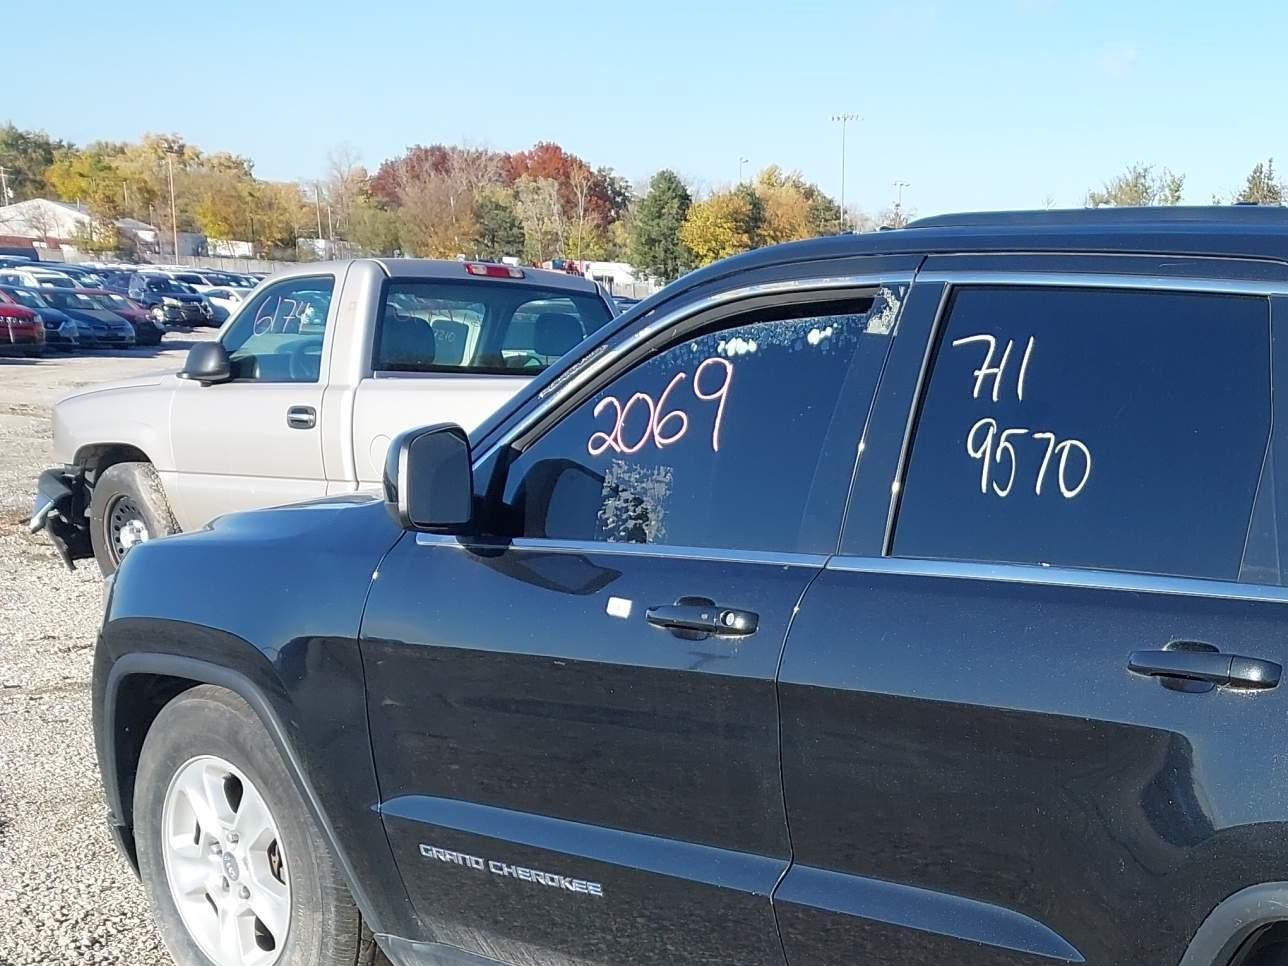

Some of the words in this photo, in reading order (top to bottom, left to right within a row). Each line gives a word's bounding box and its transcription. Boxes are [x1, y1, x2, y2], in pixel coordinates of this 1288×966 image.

[953, 334, 1035, 402] 711
[588, 357, 734, 456] 2069
[966, 417, 1092, 498] 9570
[418, 843, 485, 871] GRAND
[488, 860, 603, 897] CHEROKEE
